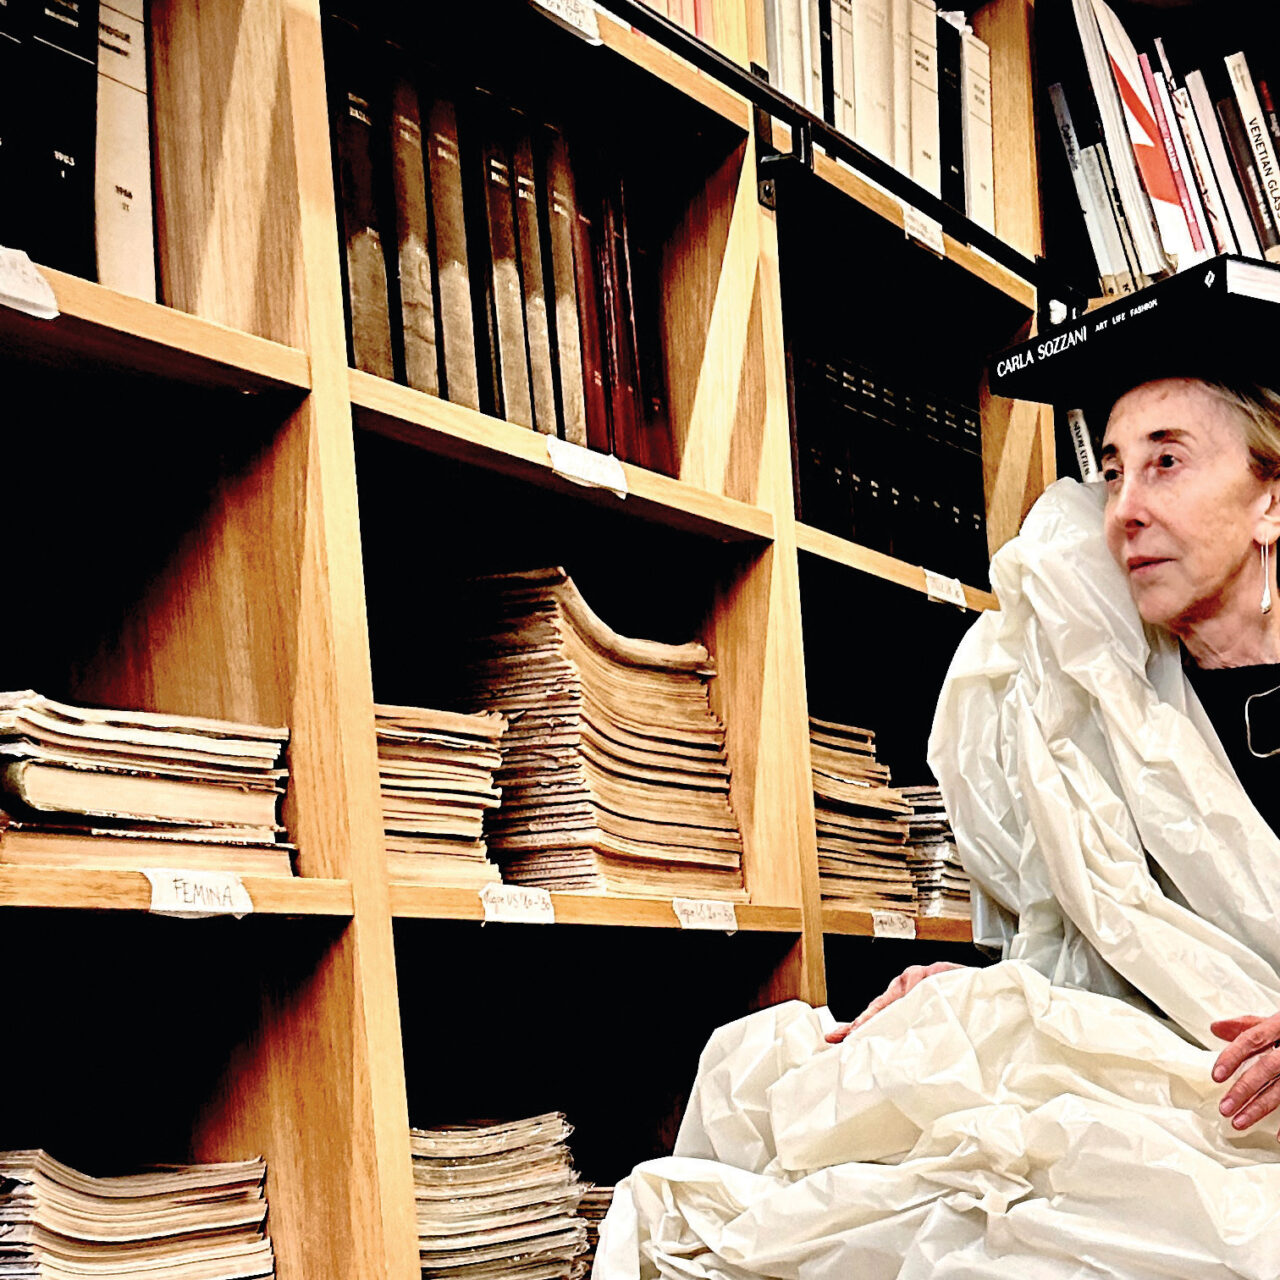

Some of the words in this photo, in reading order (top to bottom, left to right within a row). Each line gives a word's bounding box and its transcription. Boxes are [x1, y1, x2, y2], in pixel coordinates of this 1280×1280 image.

[1247, 117, 1272, 179] VENETIAN
[996, 353, 1034, 378] CARLA
[1038, 326, 1088, 360] SOZZANI
[1095, 322, 1108, 333] ART
[1112, 313, 1126, 325] LIFE
[1130, 299, 1158, 317] FASHION
[170, 876, 236, 910] FEMINA
